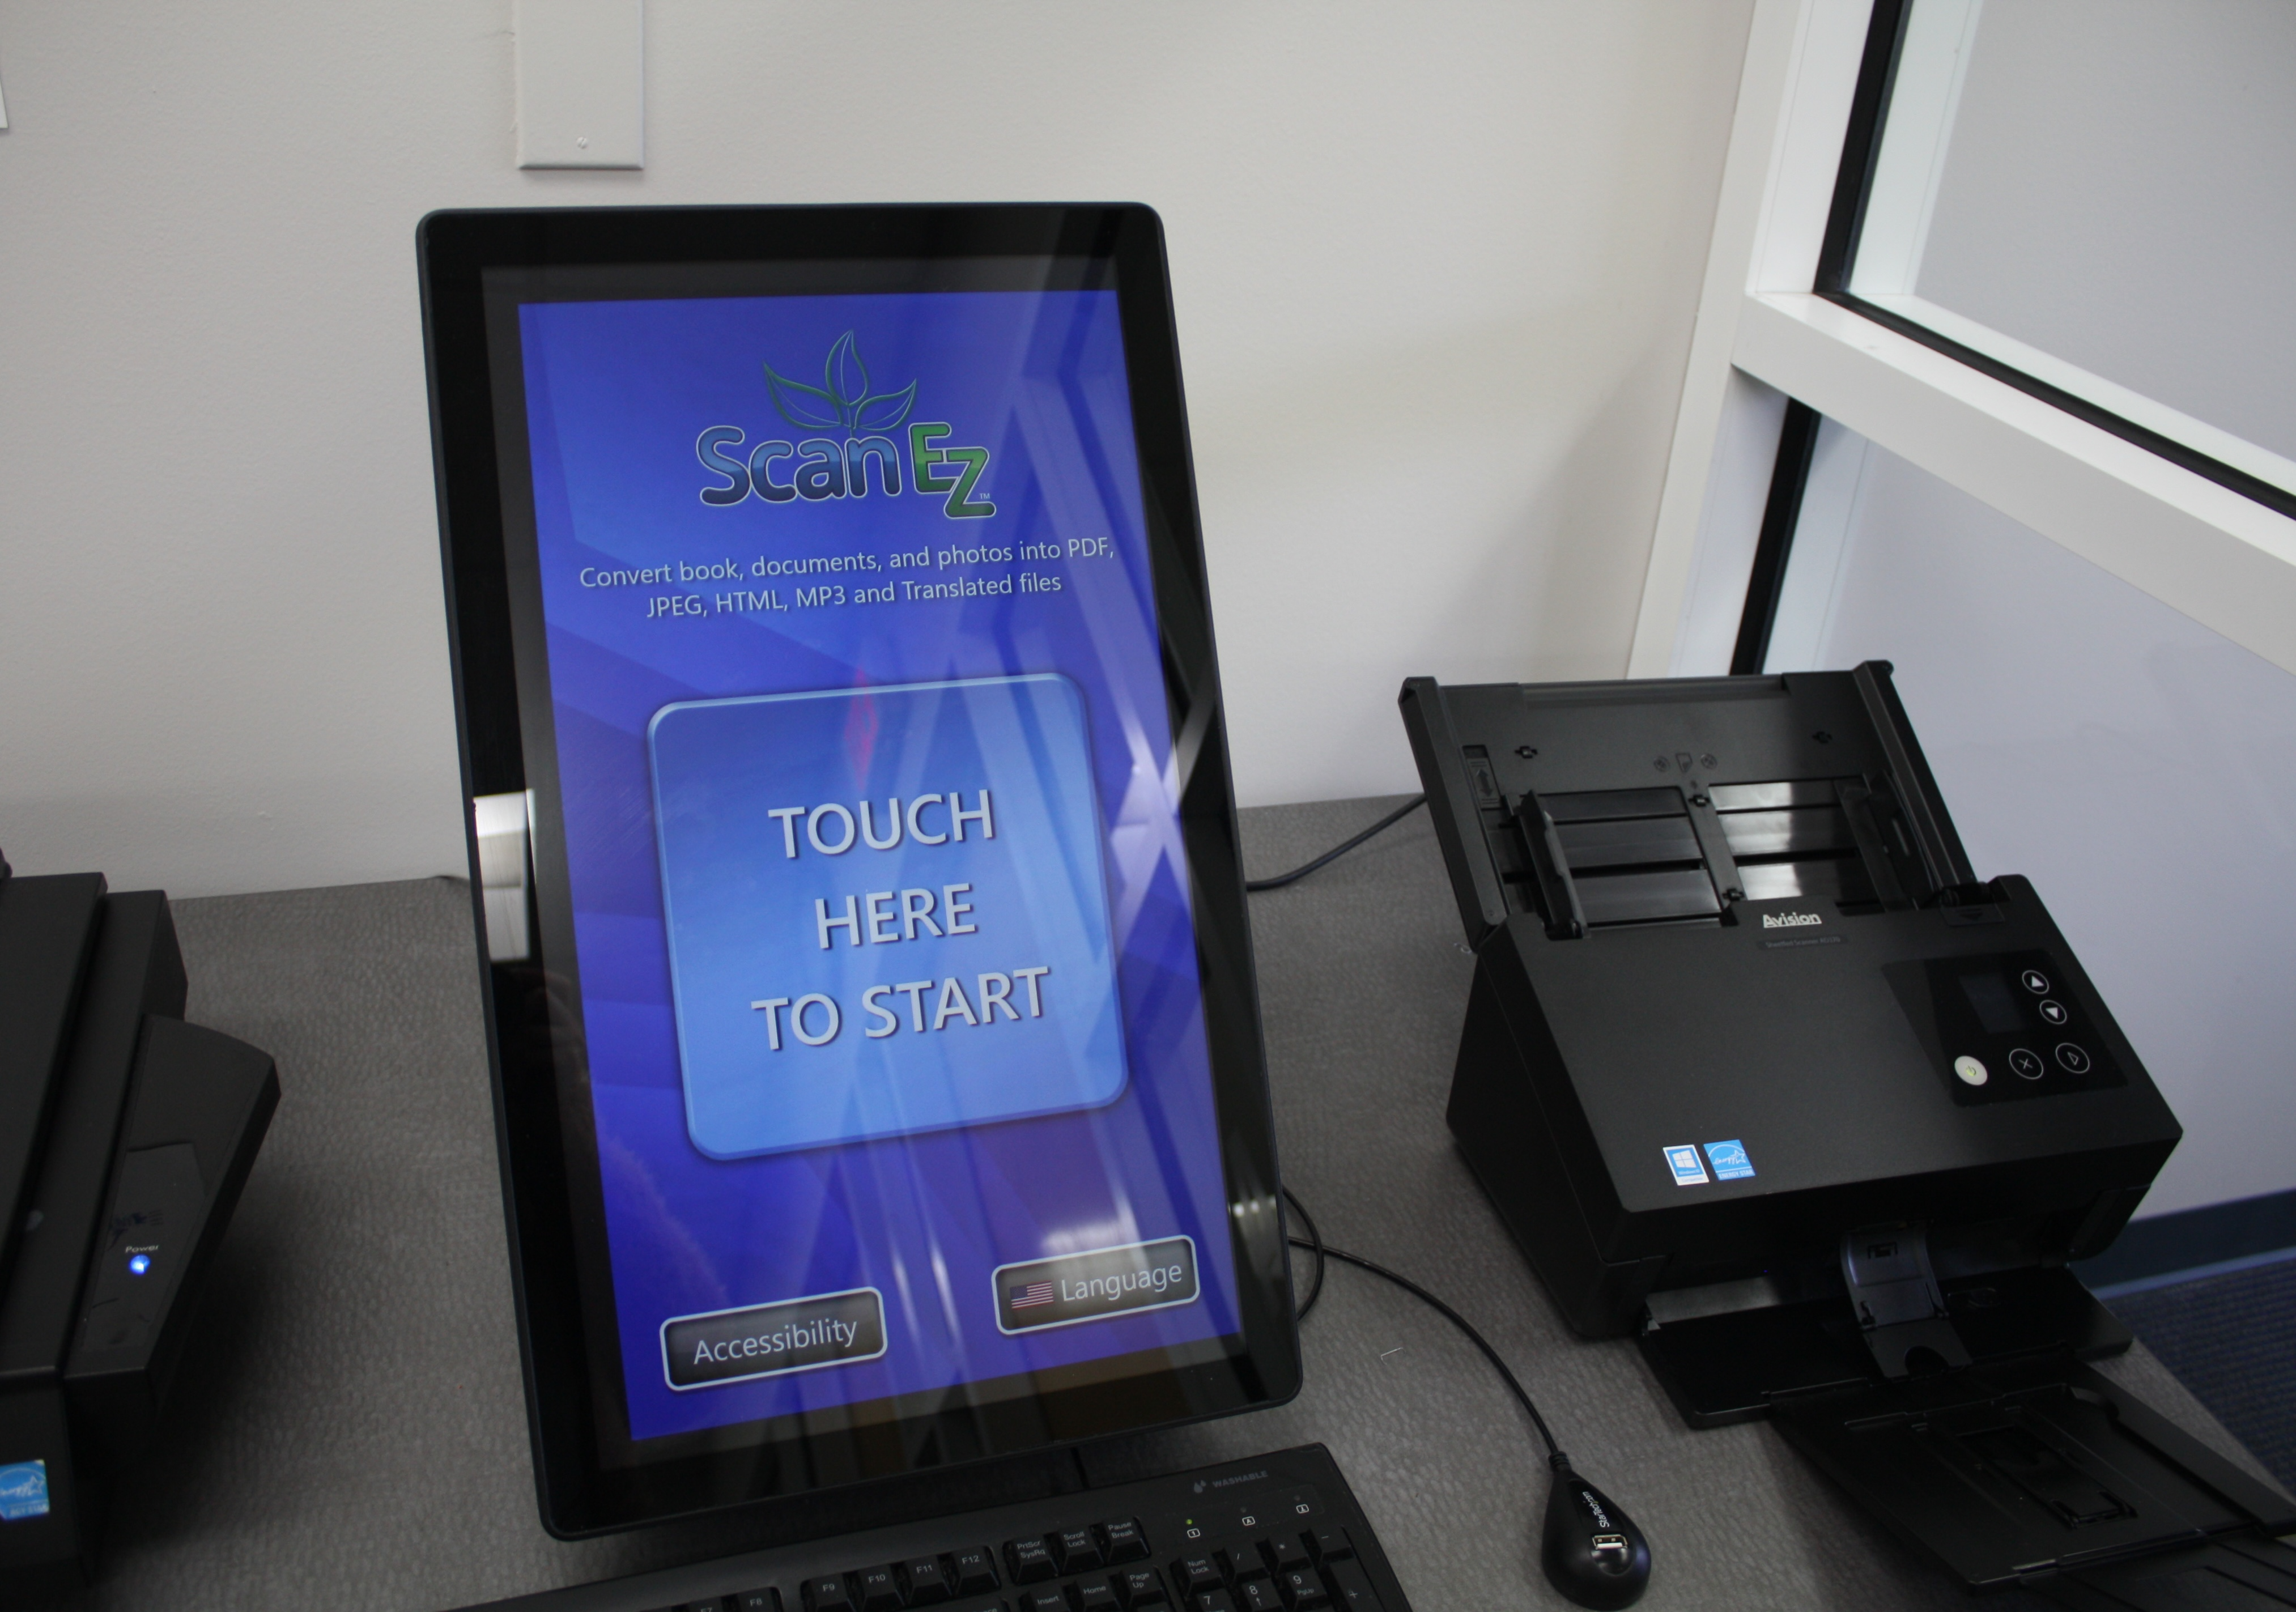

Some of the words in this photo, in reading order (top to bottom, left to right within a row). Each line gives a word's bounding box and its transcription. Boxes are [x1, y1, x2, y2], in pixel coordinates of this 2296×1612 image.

[580, 564, 672, 587] Convert
[680, 558, 743, 580] book,
[751, 551, 881, 576] documents,
[890, 546, 929, 568] and
[938, 544, 1013, 569] photos
[1019, 541, 1060, 560] into
[1068, 537, 1114, 559] PDF,
[647, 595, 707, 618] JPEG,
[716, 589, 788, 613] HTML,
[796, 585, 845, 607] MP3
[854, 581, 895, 603] and
[902, 574, 1012, 601] Translated
[1019, 572, 1061, 593] files
[768, 789, 994, 858] TOUCH
[815, 882, 976, 950] HERE
[1763, 912, 1822, 928] Avision
[751, 993, 841, 1050] TO
[861, 966, 1049, 1038] START
[1061, 1264, 1182, 1301] Language
[694, 1318, 857, 1365] Accessibility
[1212, 1470, 1269, 1488] WASHABLE
[1108, 1521, 1132, 1530] Pause
[1064, 1531, 1085, 1541] Scroll
[1111, 1529, 1134, 1539] Break
[1017, 1540, 1041, 1550] PrtScr
[1067, 1539, 1086, 1548] Lock
[1020, 1549, 1045, 1559] SysRq
[962, 1555, 980, 1564] F12
[1188, 1559, 1206, 1568] Num
[916, 1564, 933, 1573] F11
[1190, 1566, 1210, 1575] Lock
[868, 1574, 886, 1583] F10
[1129, 1572, 1150, 1581] Page
[1293, 1575, 1302, 1584] 9
[823, 1584, 835, 1592] F9
[1083, 1585, 1107, 1594] Home
[1132, 1581, 1144, 1590] Up
[1249, 1585, 1258, 1595] 8
[750, 1598, 763, 1607] F8
[1037, 1595, 1060, 1605] Insert
[1204, 1596, 1210, 1605] 7
